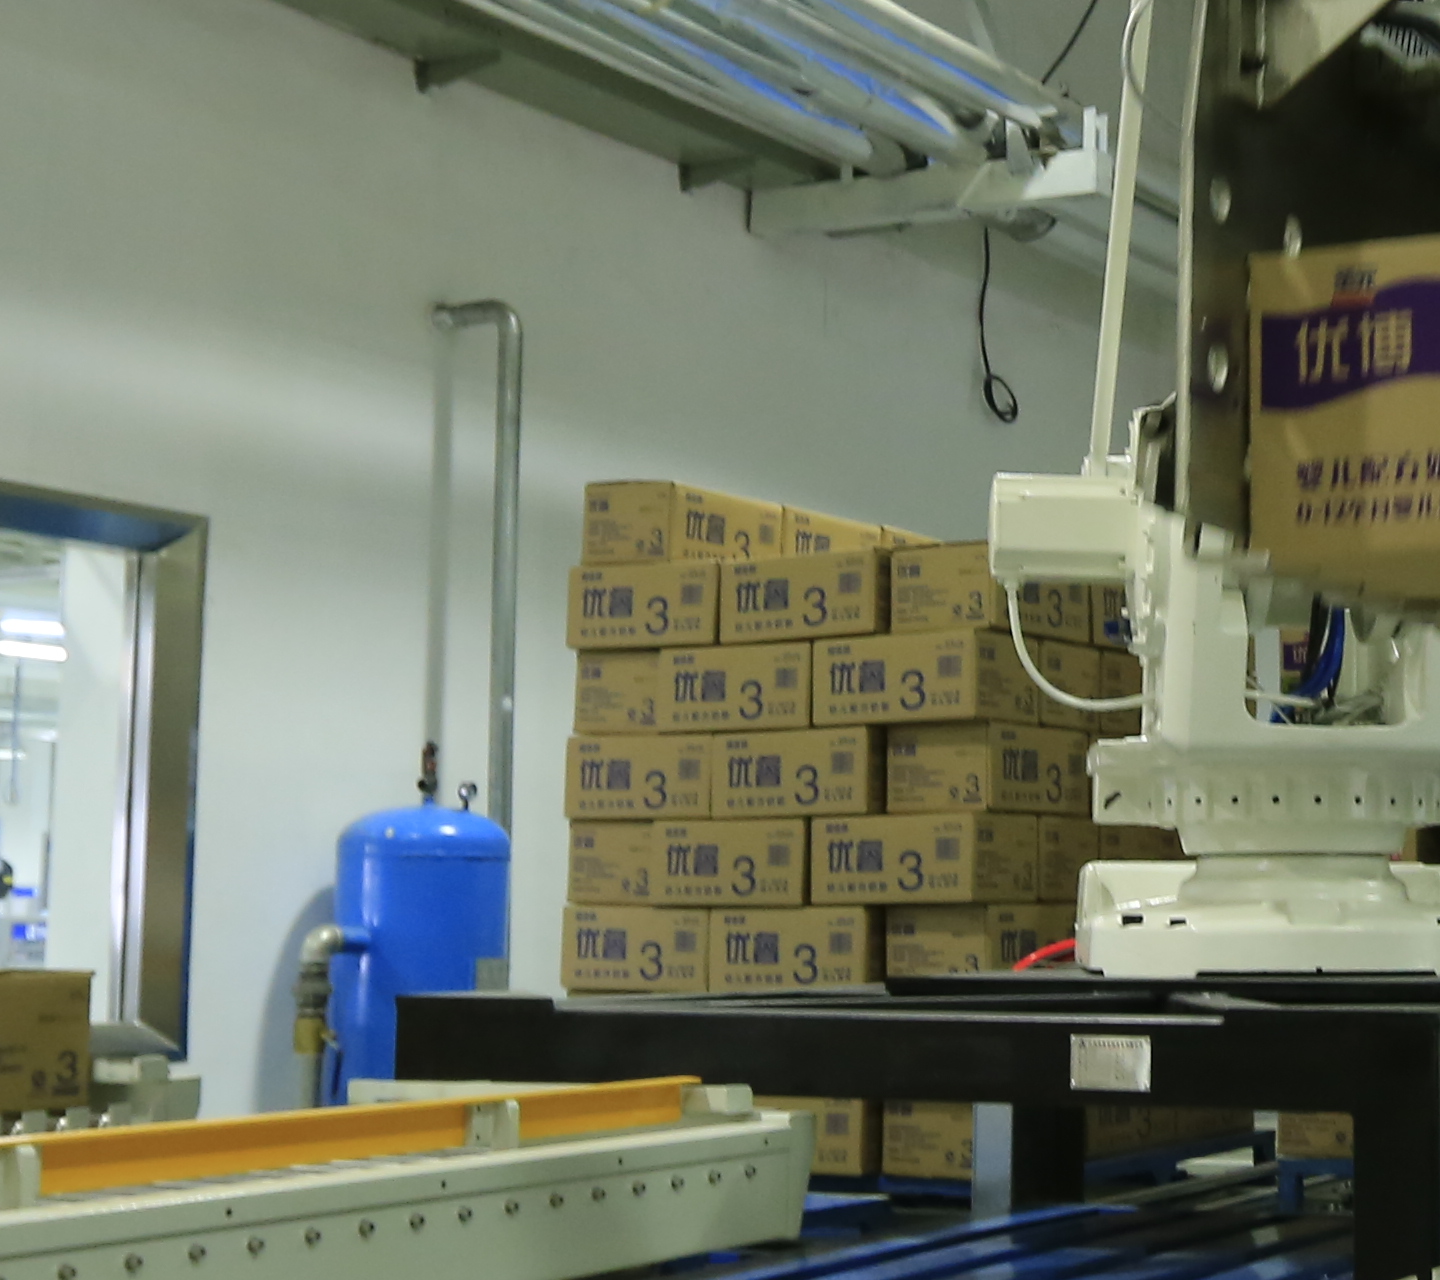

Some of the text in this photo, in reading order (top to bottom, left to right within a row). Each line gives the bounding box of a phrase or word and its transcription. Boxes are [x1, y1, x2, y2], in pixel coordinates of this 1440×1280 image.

[1295, 308, 1413, 385] 优博
[645, 596, 669, 636] 3
[802, 586, 828, 626] 3
[1047, 589, 1063, 627] 3
[739, 679, 764, 719] 3
[899, 669, 926, 711] 3
[643, 770, 667, 809] 3
[794, 764, 819, 805] 3
[1046, 763, 1061, 804] 3
[731, 855, 756, 896] 3
[897, 850, 924, 891] 3
[639, 940, 663, 981] 3
[793, 943, 818, 984] 3
[57, 1051, 79, 1082] 3
